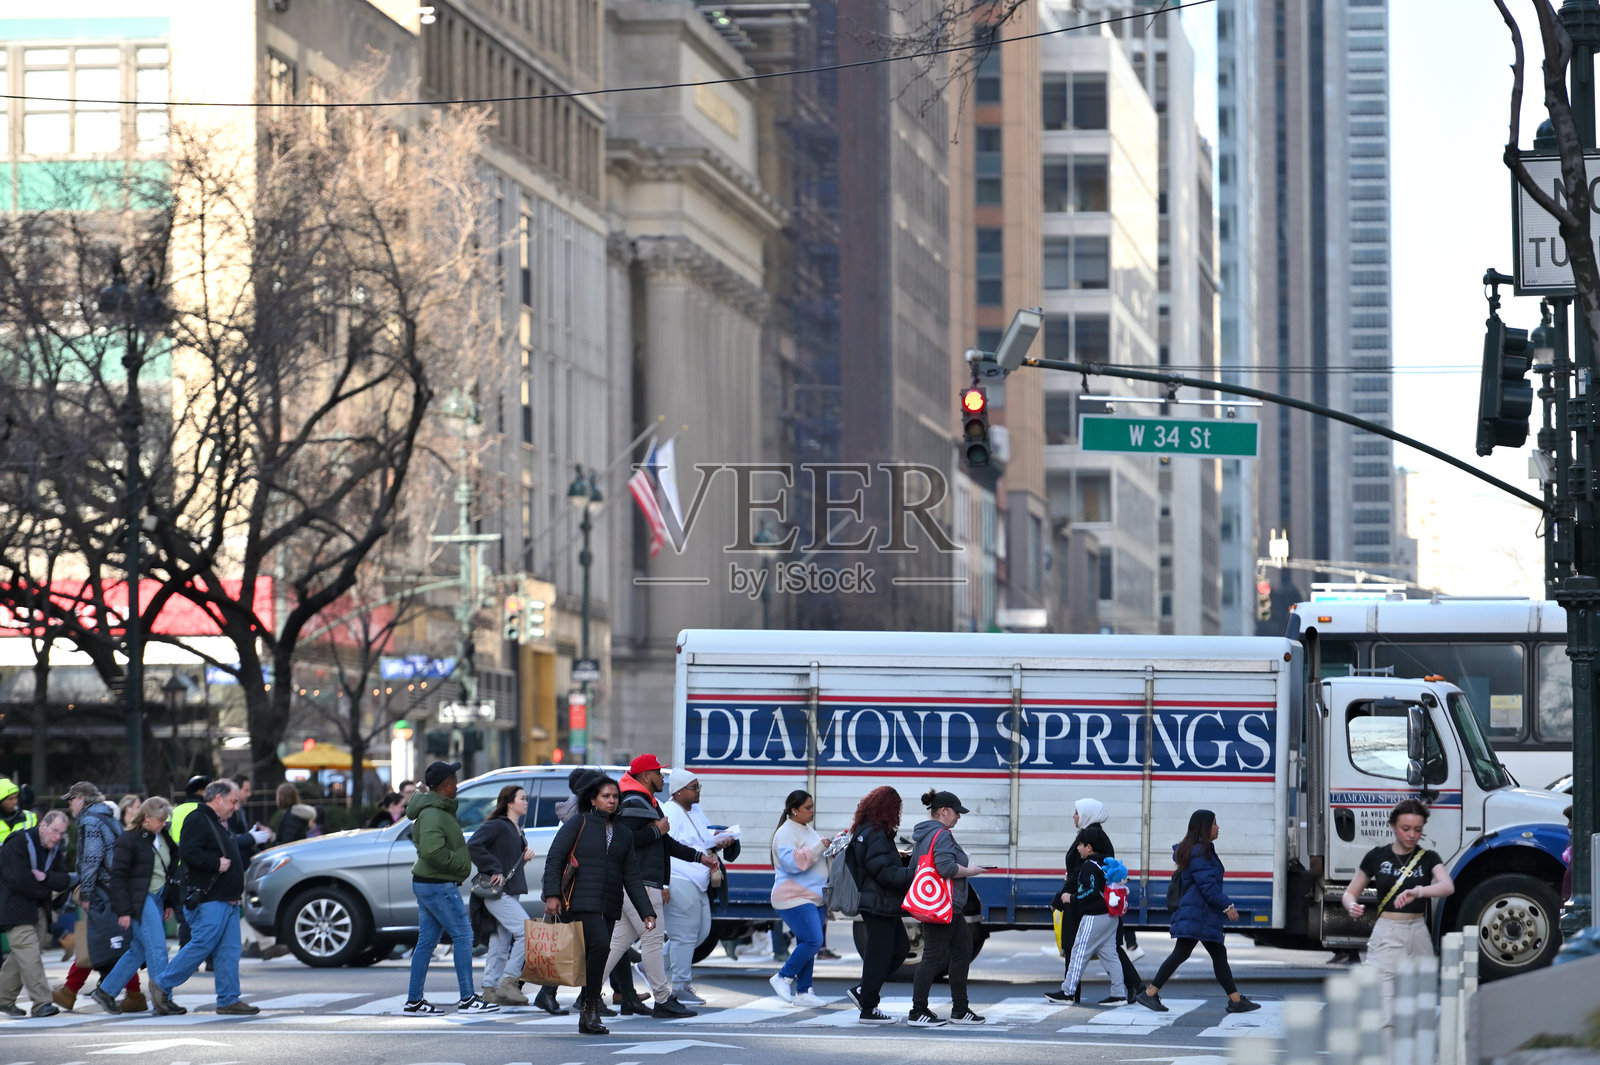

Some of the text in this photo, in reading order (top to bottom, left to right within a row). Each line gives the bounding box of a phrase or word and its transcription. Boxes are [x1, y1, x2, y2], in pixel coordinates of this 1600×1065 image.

[1129, 424, 1212, 449] W 34 St
[691, 706, 1271, 772] DIAMOND SPRINGS
[1331, 793, 1376, 803] DIAMOND
[530, 927, 560, 942] Give
[527, 950, 556, 967] Give
